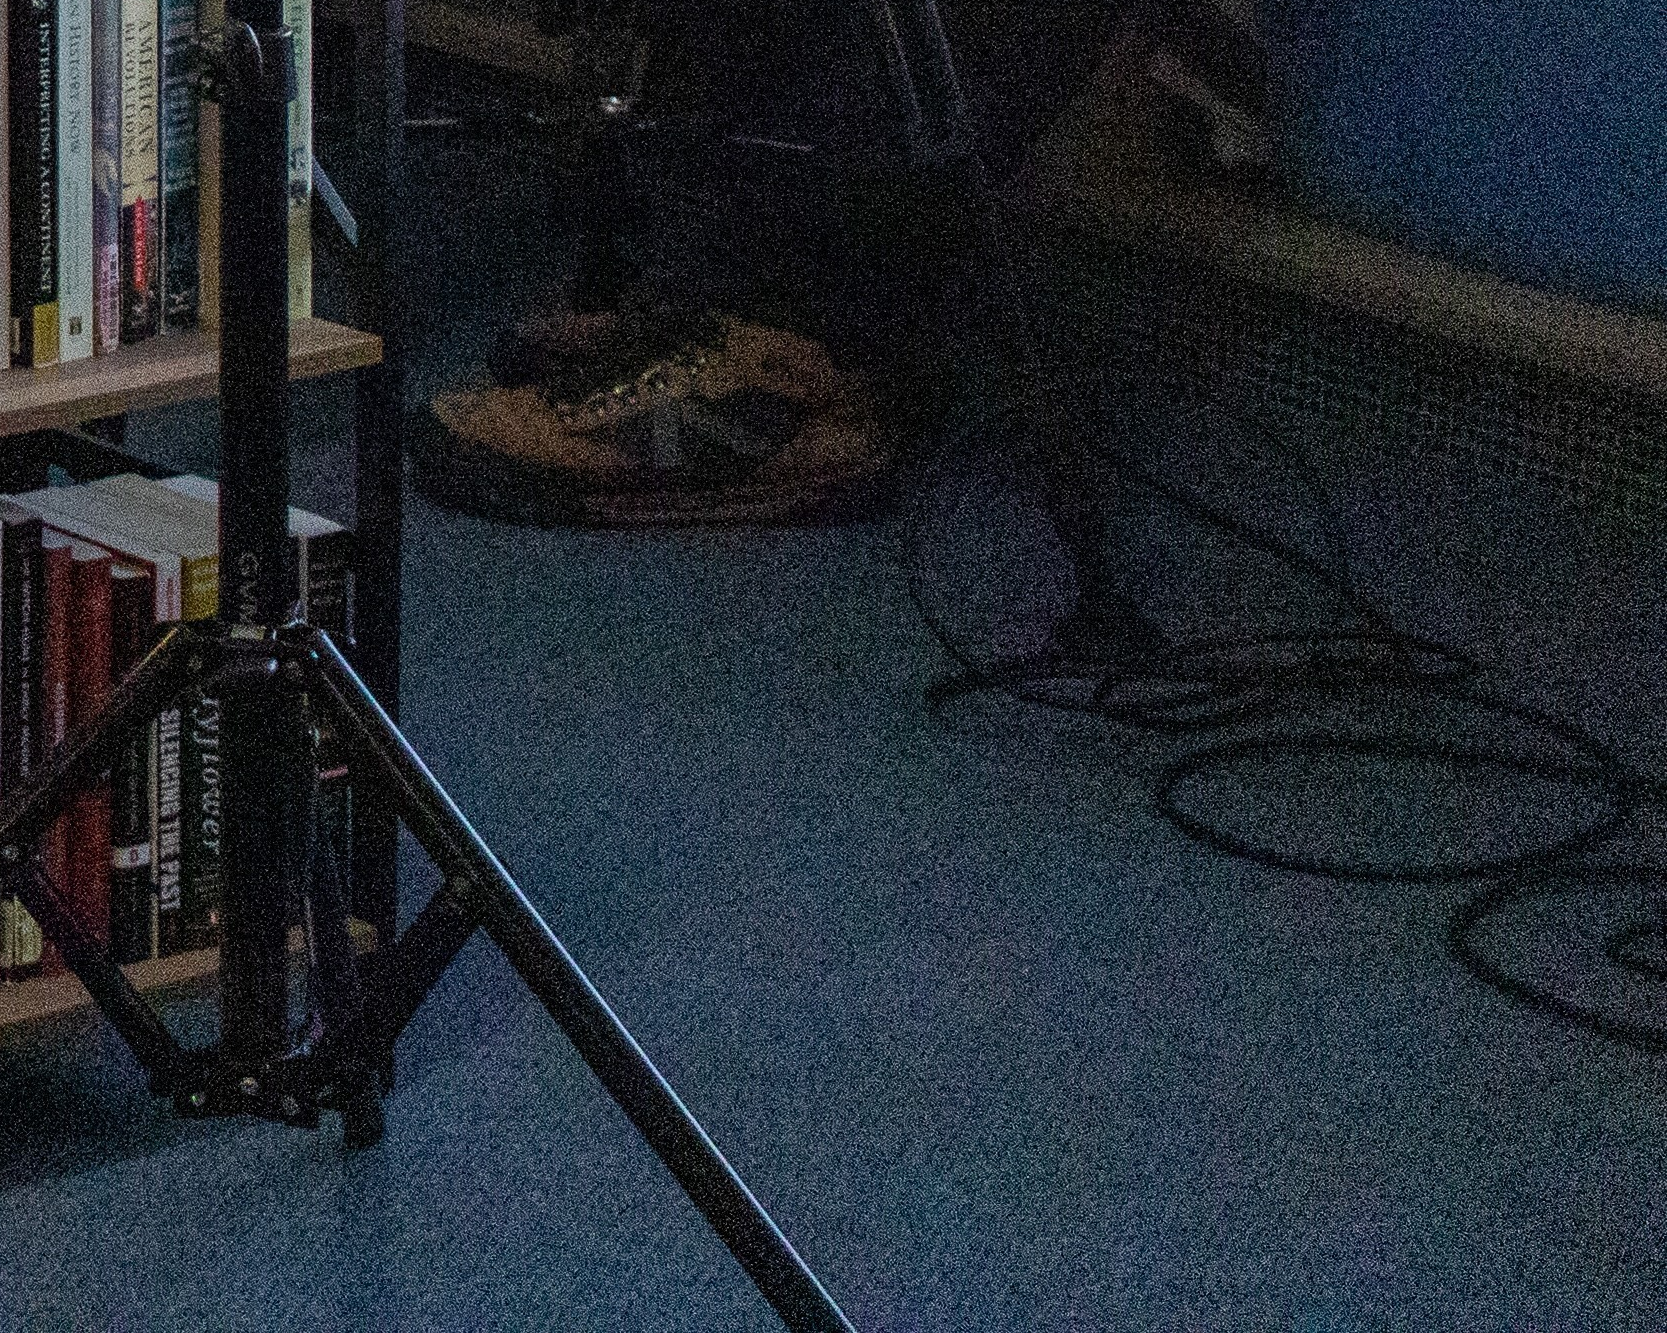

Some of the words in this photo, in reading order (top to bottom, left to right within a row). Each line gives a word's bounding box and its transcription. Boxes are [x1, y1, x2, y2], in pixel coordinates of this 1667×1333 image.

[36, 22, 52, 161] INTERPRETING
[123, 21, 137, 161] REVOLUTIONS
[137, 18, 154, 155] AMERICAN
[38, 181, 53, 294] CONTINENT
[160, 708, 181, 817] SILENCING
[159, 862, 181, 912] PAST
[160, 821, 181, 860] THE
